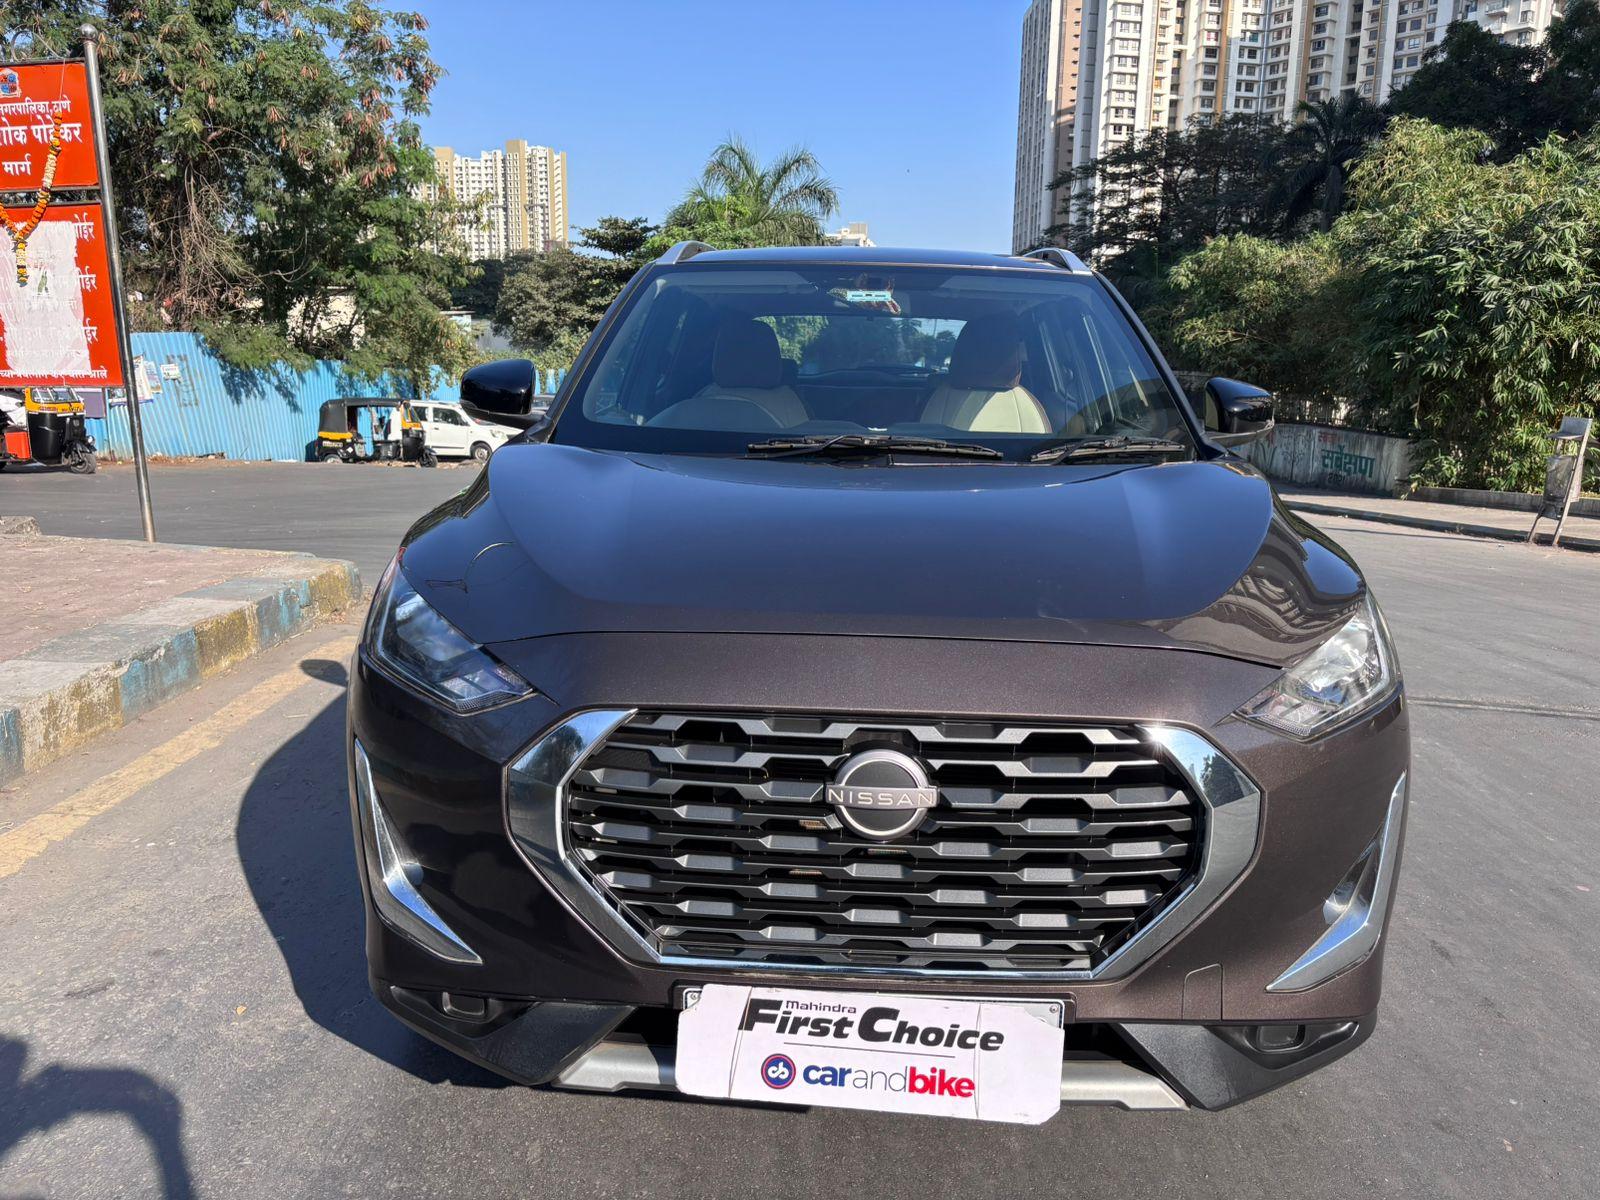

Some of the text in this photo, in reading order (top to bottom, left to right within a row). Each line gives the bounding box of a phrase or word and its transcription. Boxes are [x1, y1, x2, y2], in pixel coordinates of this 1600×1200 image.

[2, 153, 32, 176] मार्ग
[828, 789, 933, 807] NISSAN
[738, 998, 1005, 1051] First Choice
[803, 1064, 975, 1098] carandbike
